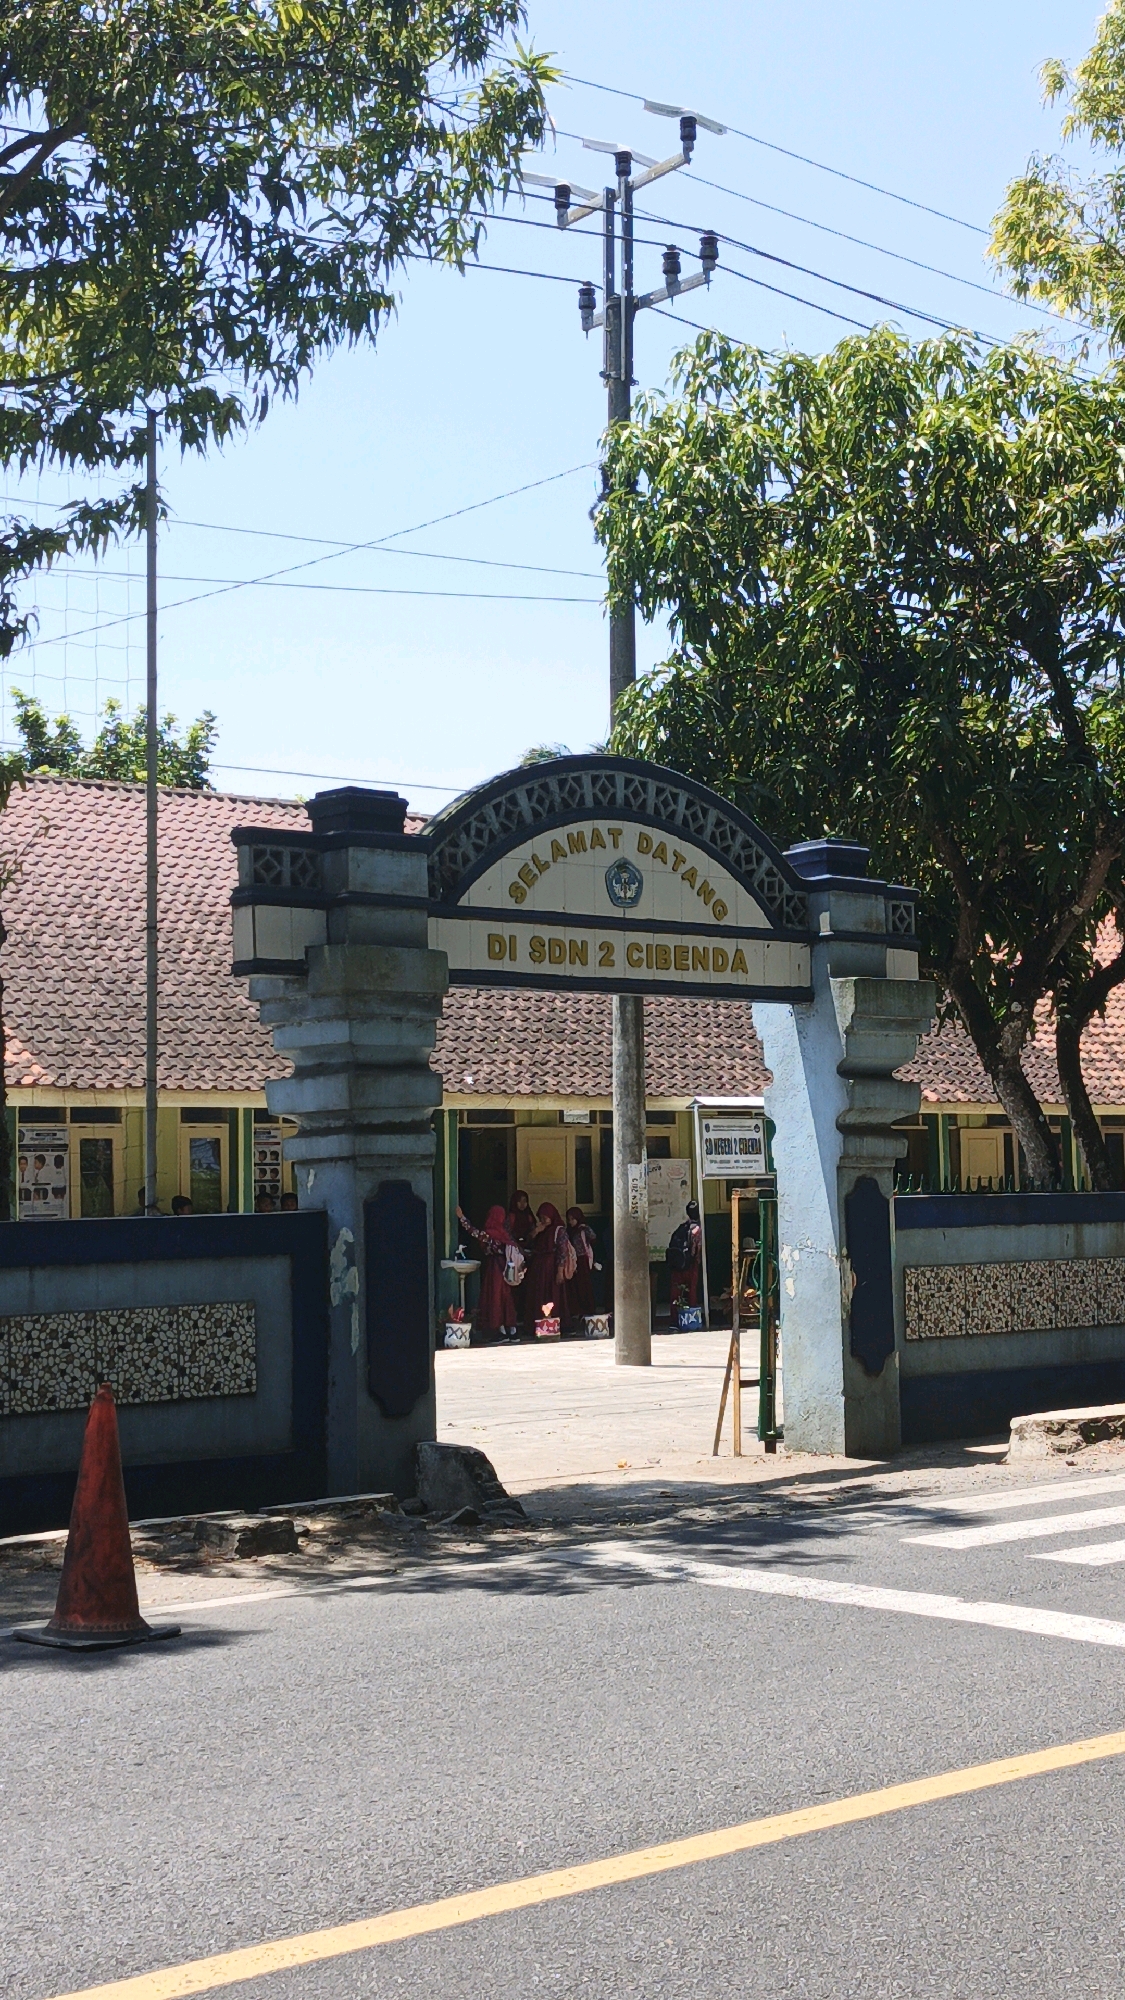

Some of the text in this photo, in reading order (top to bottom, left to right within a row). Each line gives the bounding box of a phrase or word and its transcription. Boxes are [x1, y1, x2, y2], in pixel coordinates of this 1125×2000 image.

[508, 827, 729, 921] SELAMAT DATANG
[487, 933, 749, 974] DI SDN 2 CIBENDA
